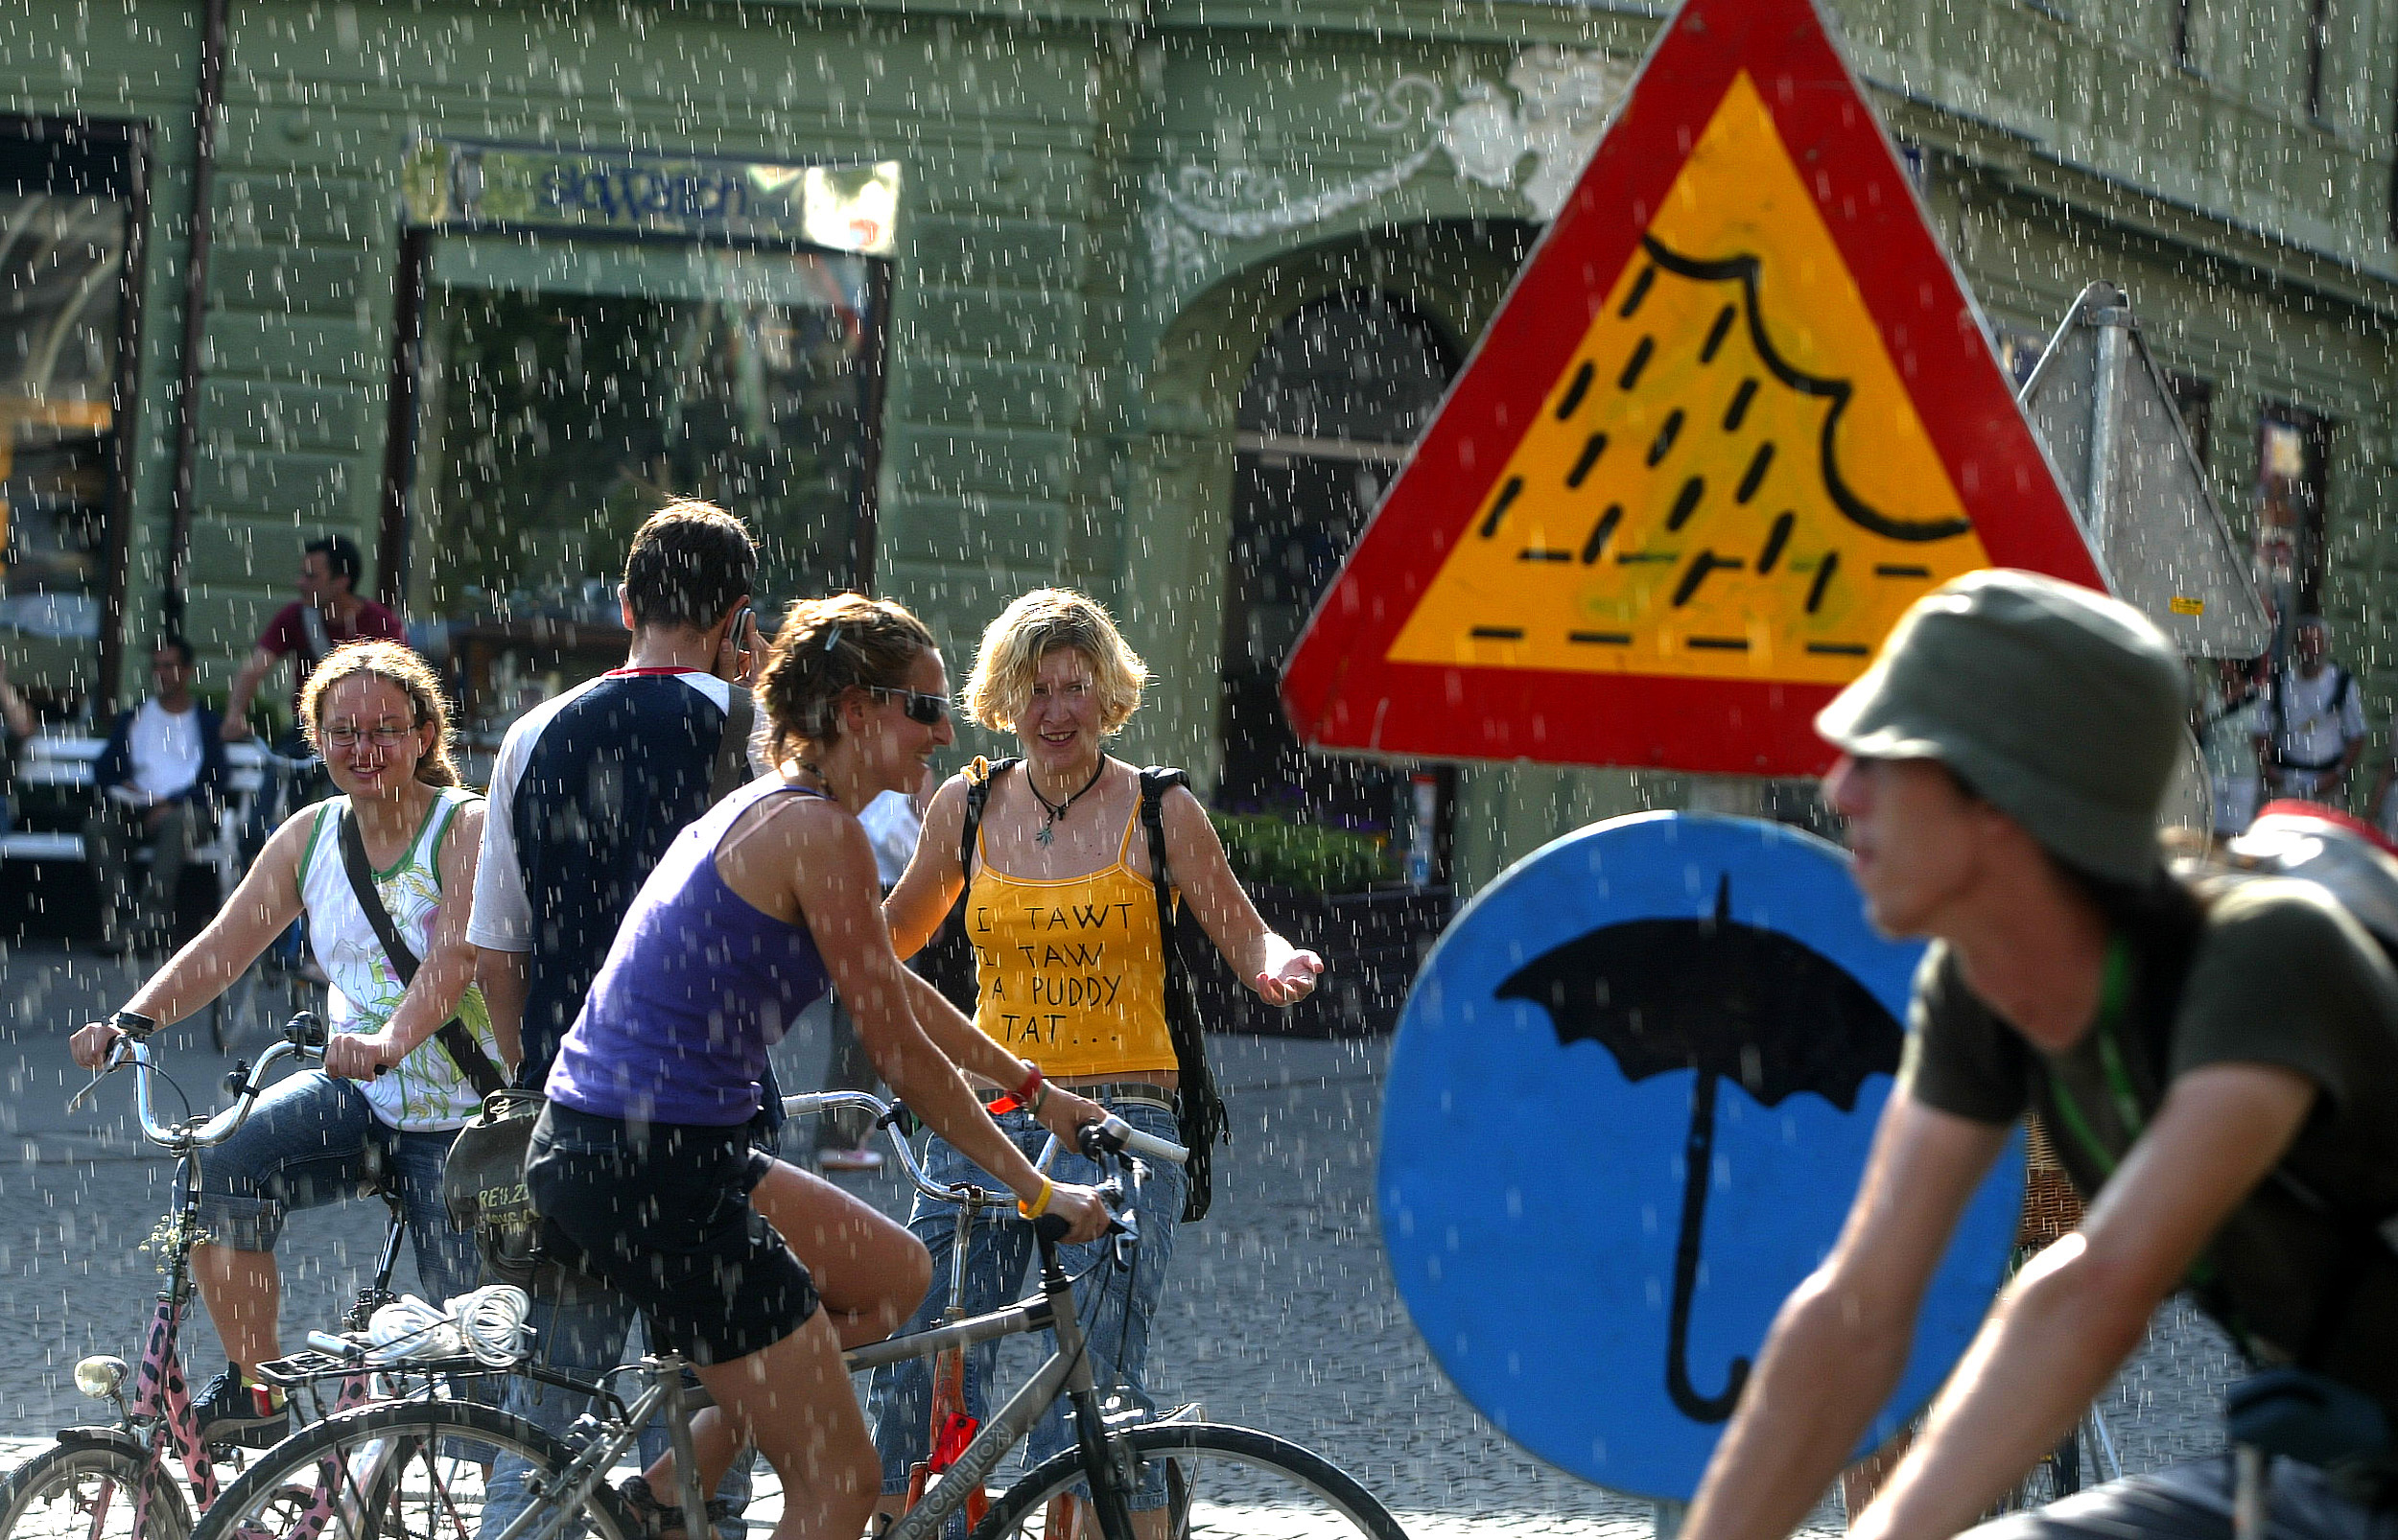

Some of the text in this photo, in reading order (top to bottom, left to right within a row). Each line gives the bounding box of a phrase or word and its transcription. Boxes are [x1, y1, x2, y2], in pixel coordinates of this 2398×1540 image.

[976, 902, 1134, 932] I TAWT
[976, 943, 1103, 968] I TAW
[992, 975, 1121, 1007] A PUDDY
[903, 1421, 1015, 1537] DECATHLON
